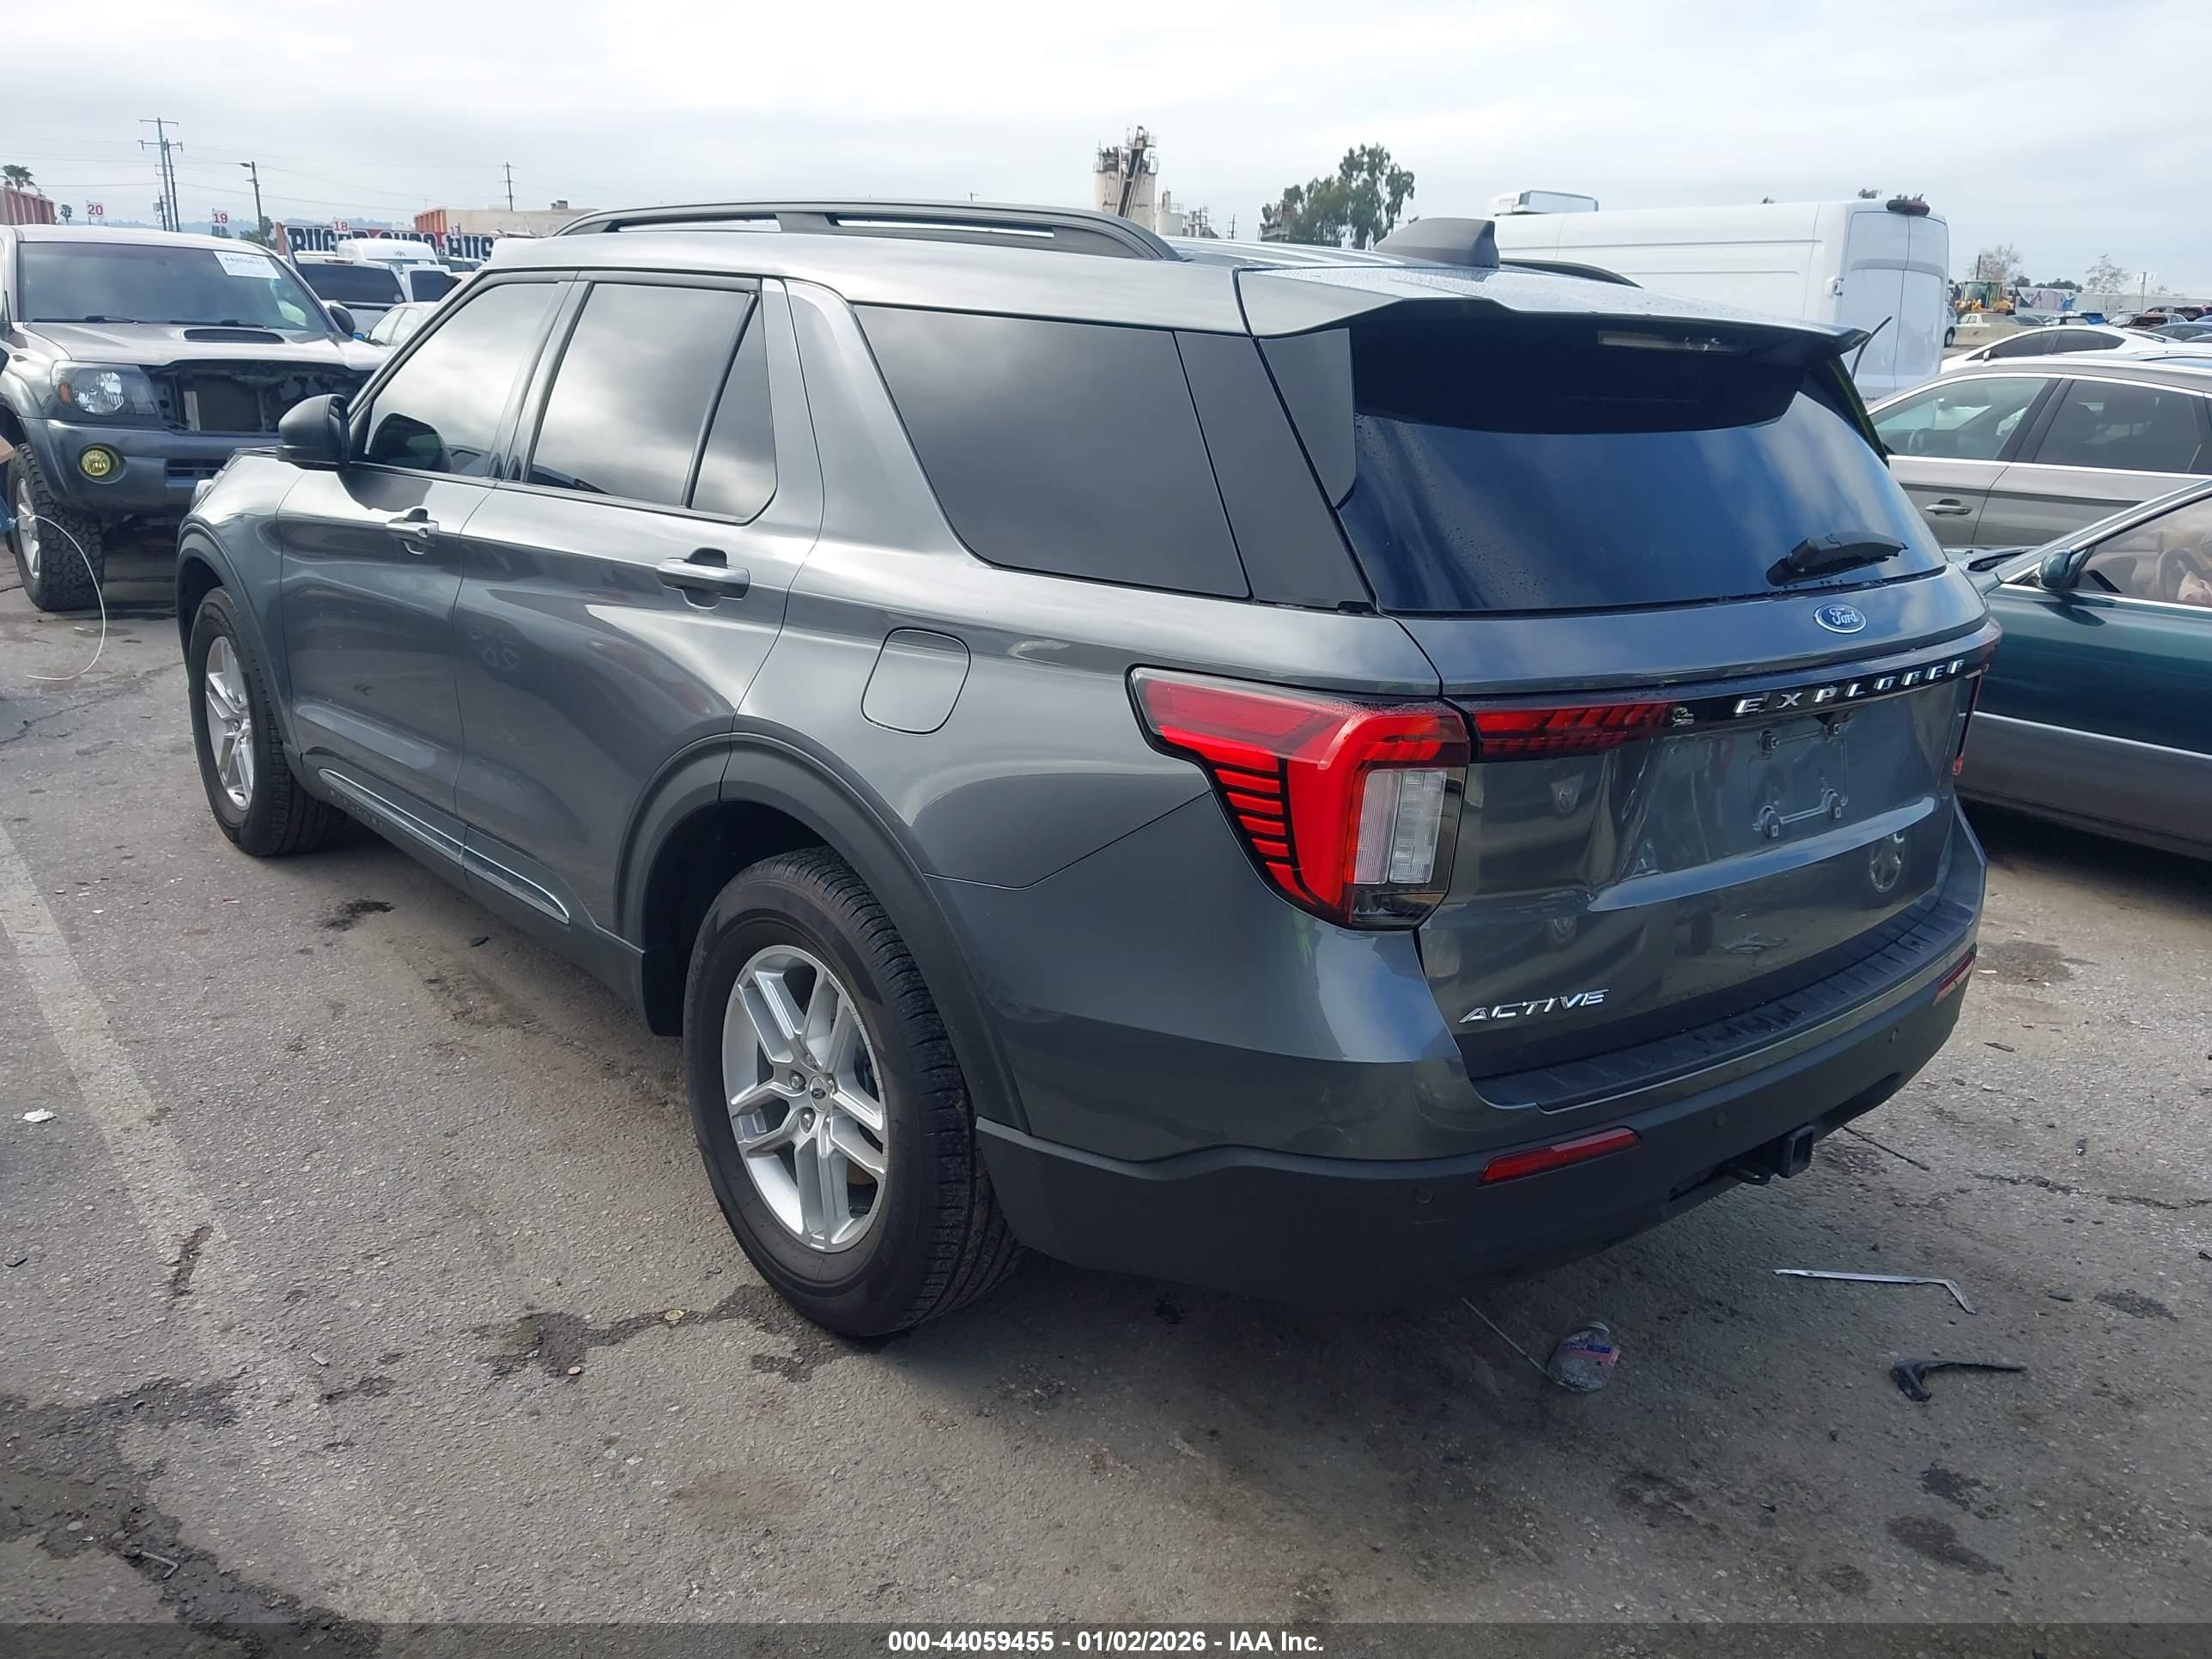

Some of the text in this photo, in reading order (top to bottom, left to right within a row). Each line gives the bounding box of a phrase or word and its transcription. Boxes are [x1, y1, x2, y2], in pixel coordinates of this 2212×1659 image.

[87, 204, 104, 216] 20
[213, 212, 228, 224] 19
[334, 221, 349, 232] 18
[1734, 659, 1966, 718] EXPLORER
[1458, 988, 1610, 1024] ACTIVE
